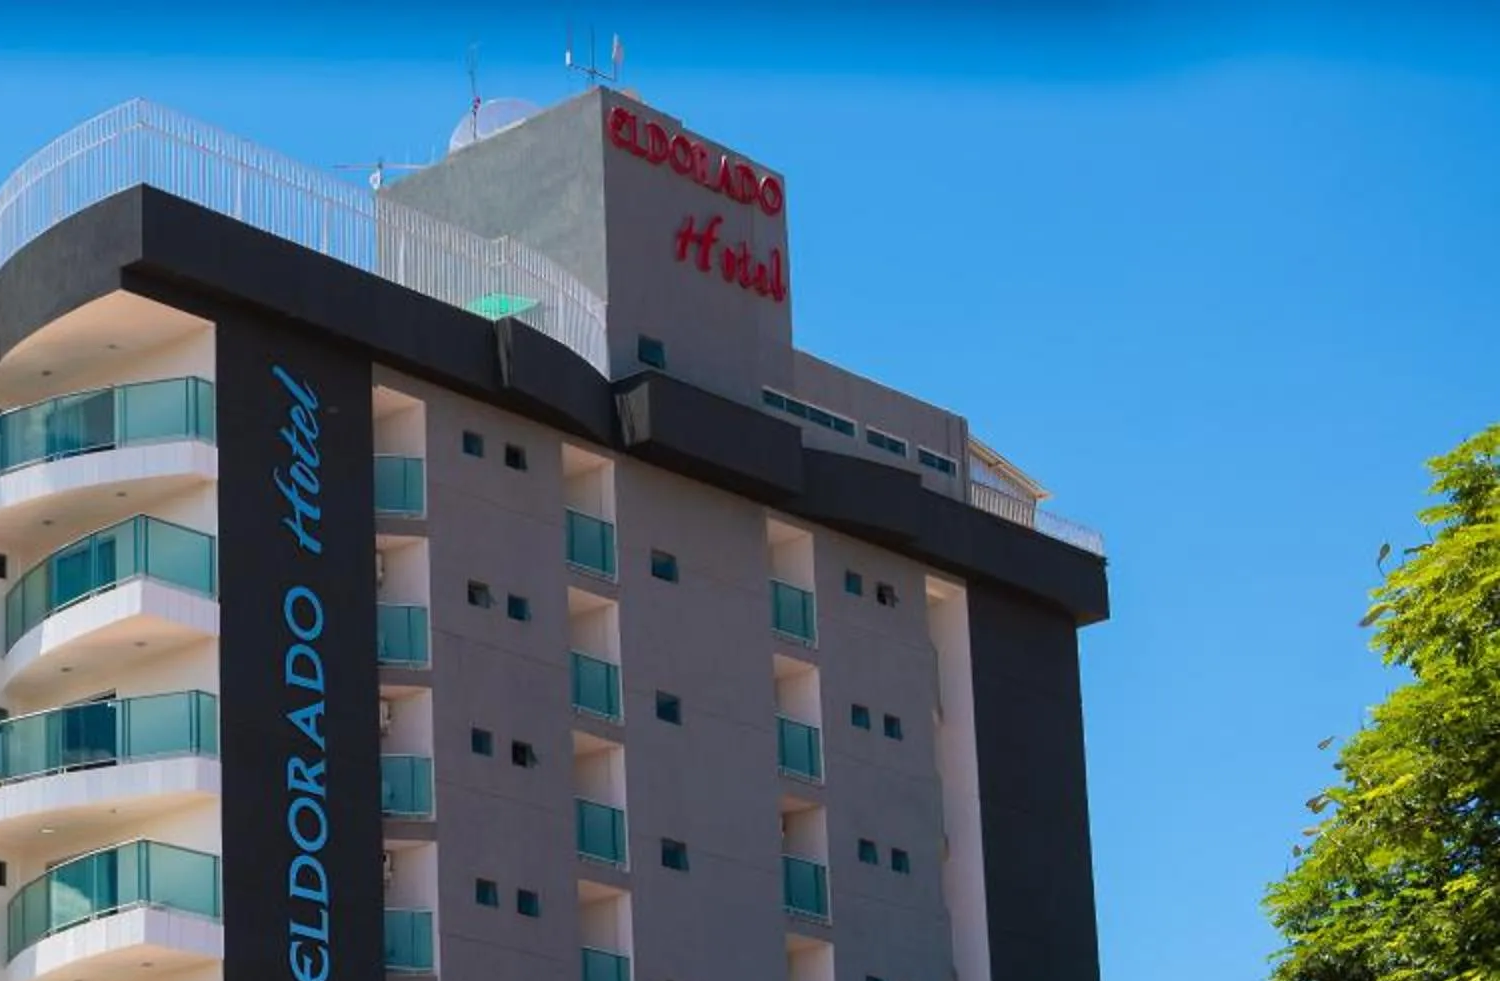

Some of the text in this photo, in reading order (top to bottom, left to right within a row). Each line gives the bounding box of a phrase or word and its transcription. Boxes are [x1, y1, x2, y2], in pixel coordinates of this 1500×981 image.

[608, 106, 783, 216] ELDORADO
[675, 214, 786, 303] Hotel
[273, 364, 322, 553] Hotel
